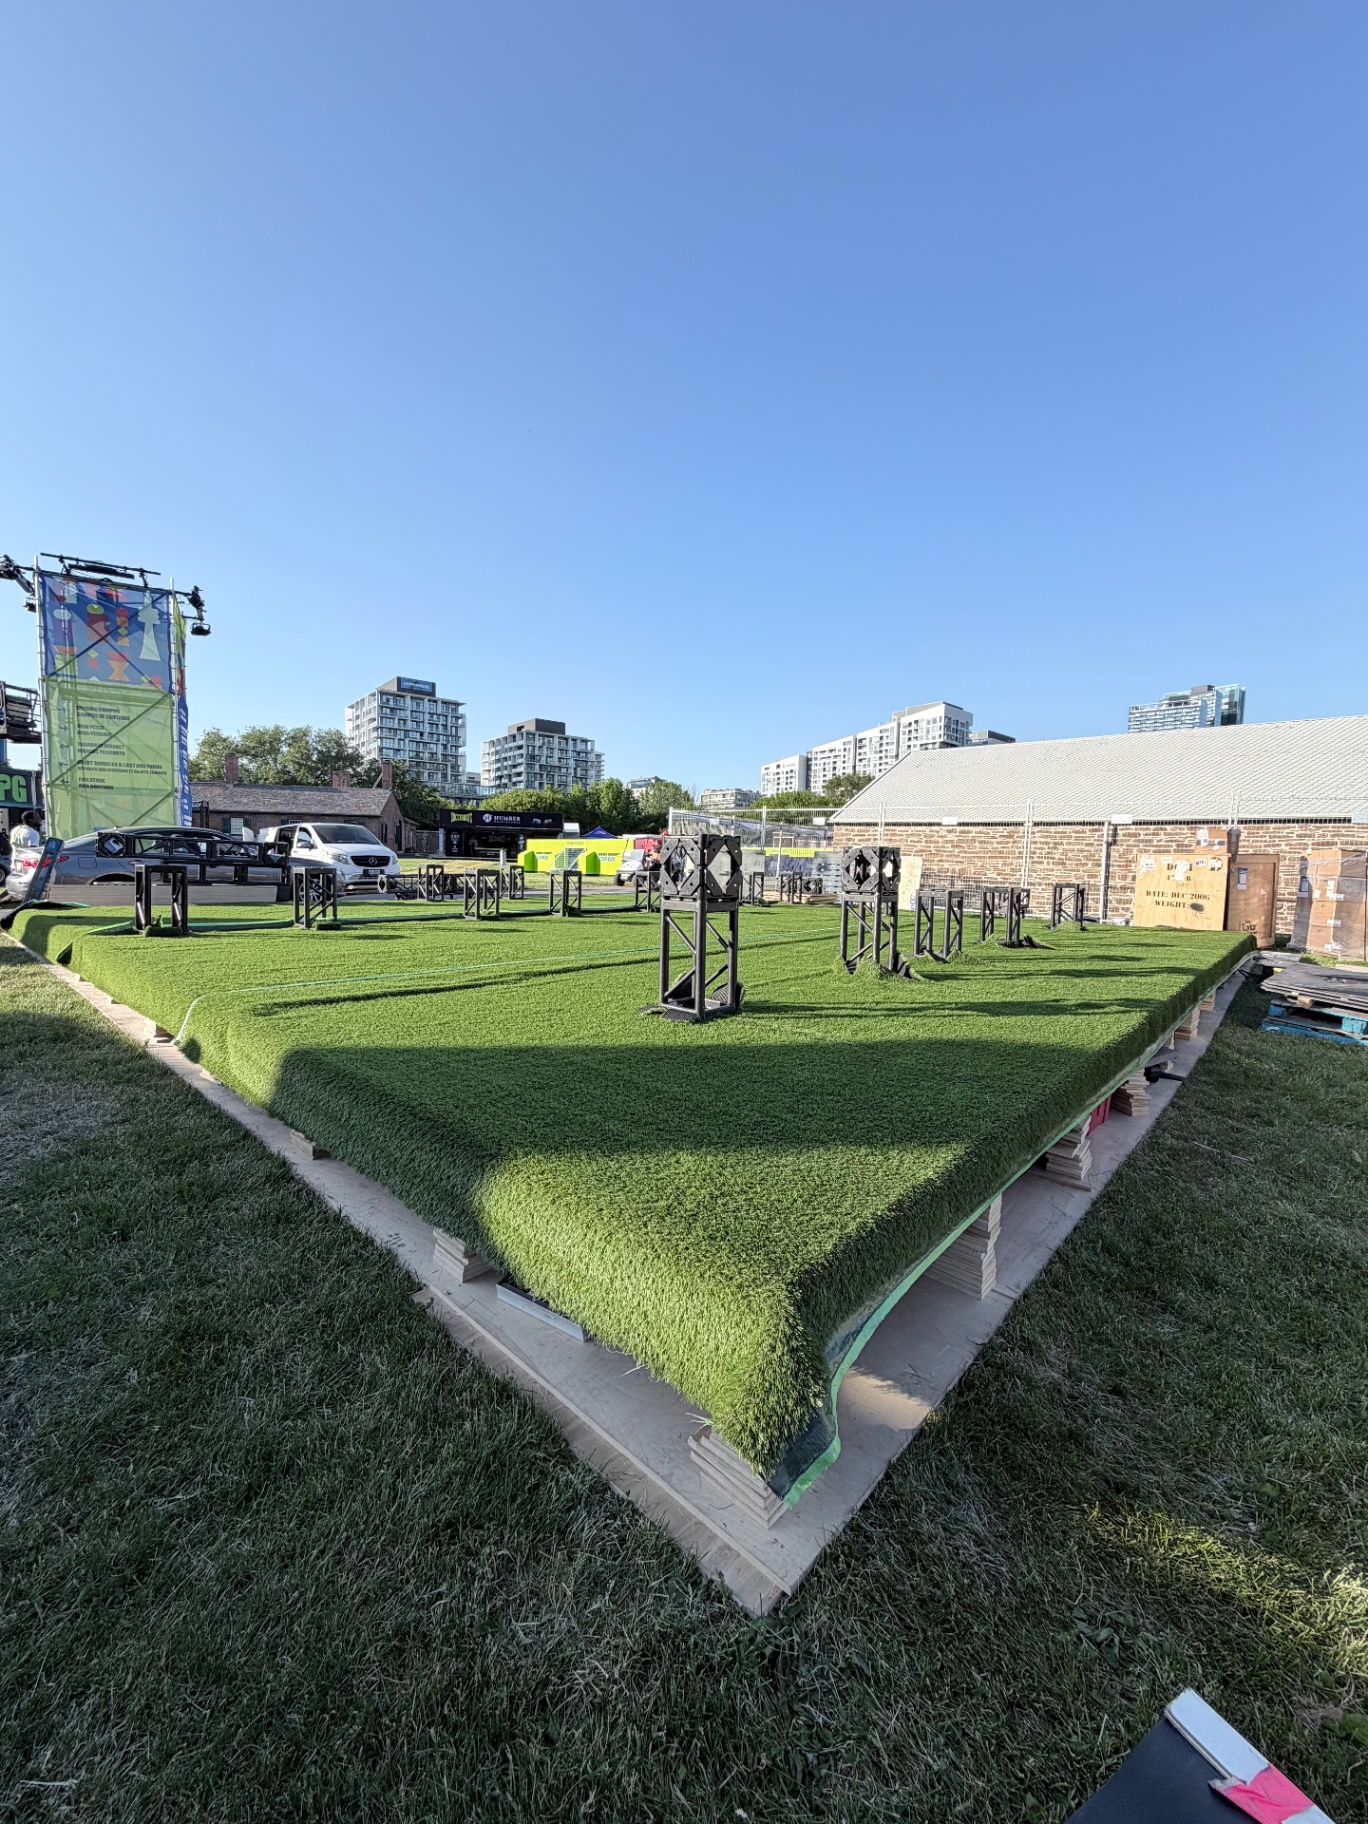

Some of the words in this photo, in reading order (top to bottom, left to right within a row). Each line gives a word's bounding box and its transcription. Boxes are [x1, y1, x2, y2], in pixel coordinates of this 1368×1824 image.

[1146, 890, 1169, 898] DATE:
[1171, 891, 1188, 899] DEC
[1189, 893, 1211, 901] 2006
[1155, 900, 1190, 909] WEIGHT:
